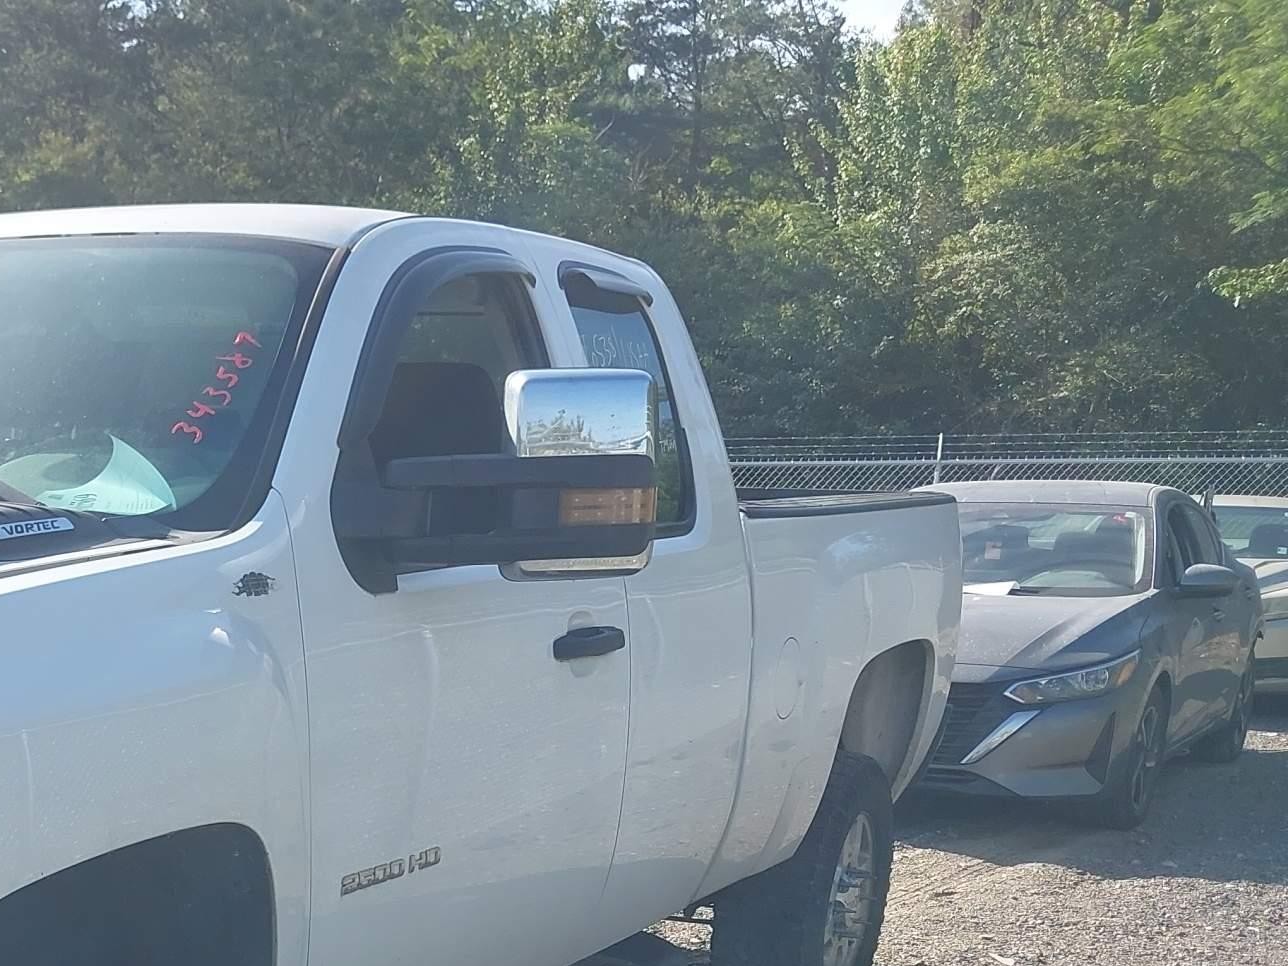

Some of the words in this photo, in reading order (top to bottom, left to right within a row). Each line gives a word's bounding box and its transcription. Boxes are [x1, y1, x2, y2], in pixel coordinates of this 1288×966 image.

[1, 520, 60, 536] VORTEC
[340, 858, 405, 897] 2500
[408, 846, 441, 874] HD
